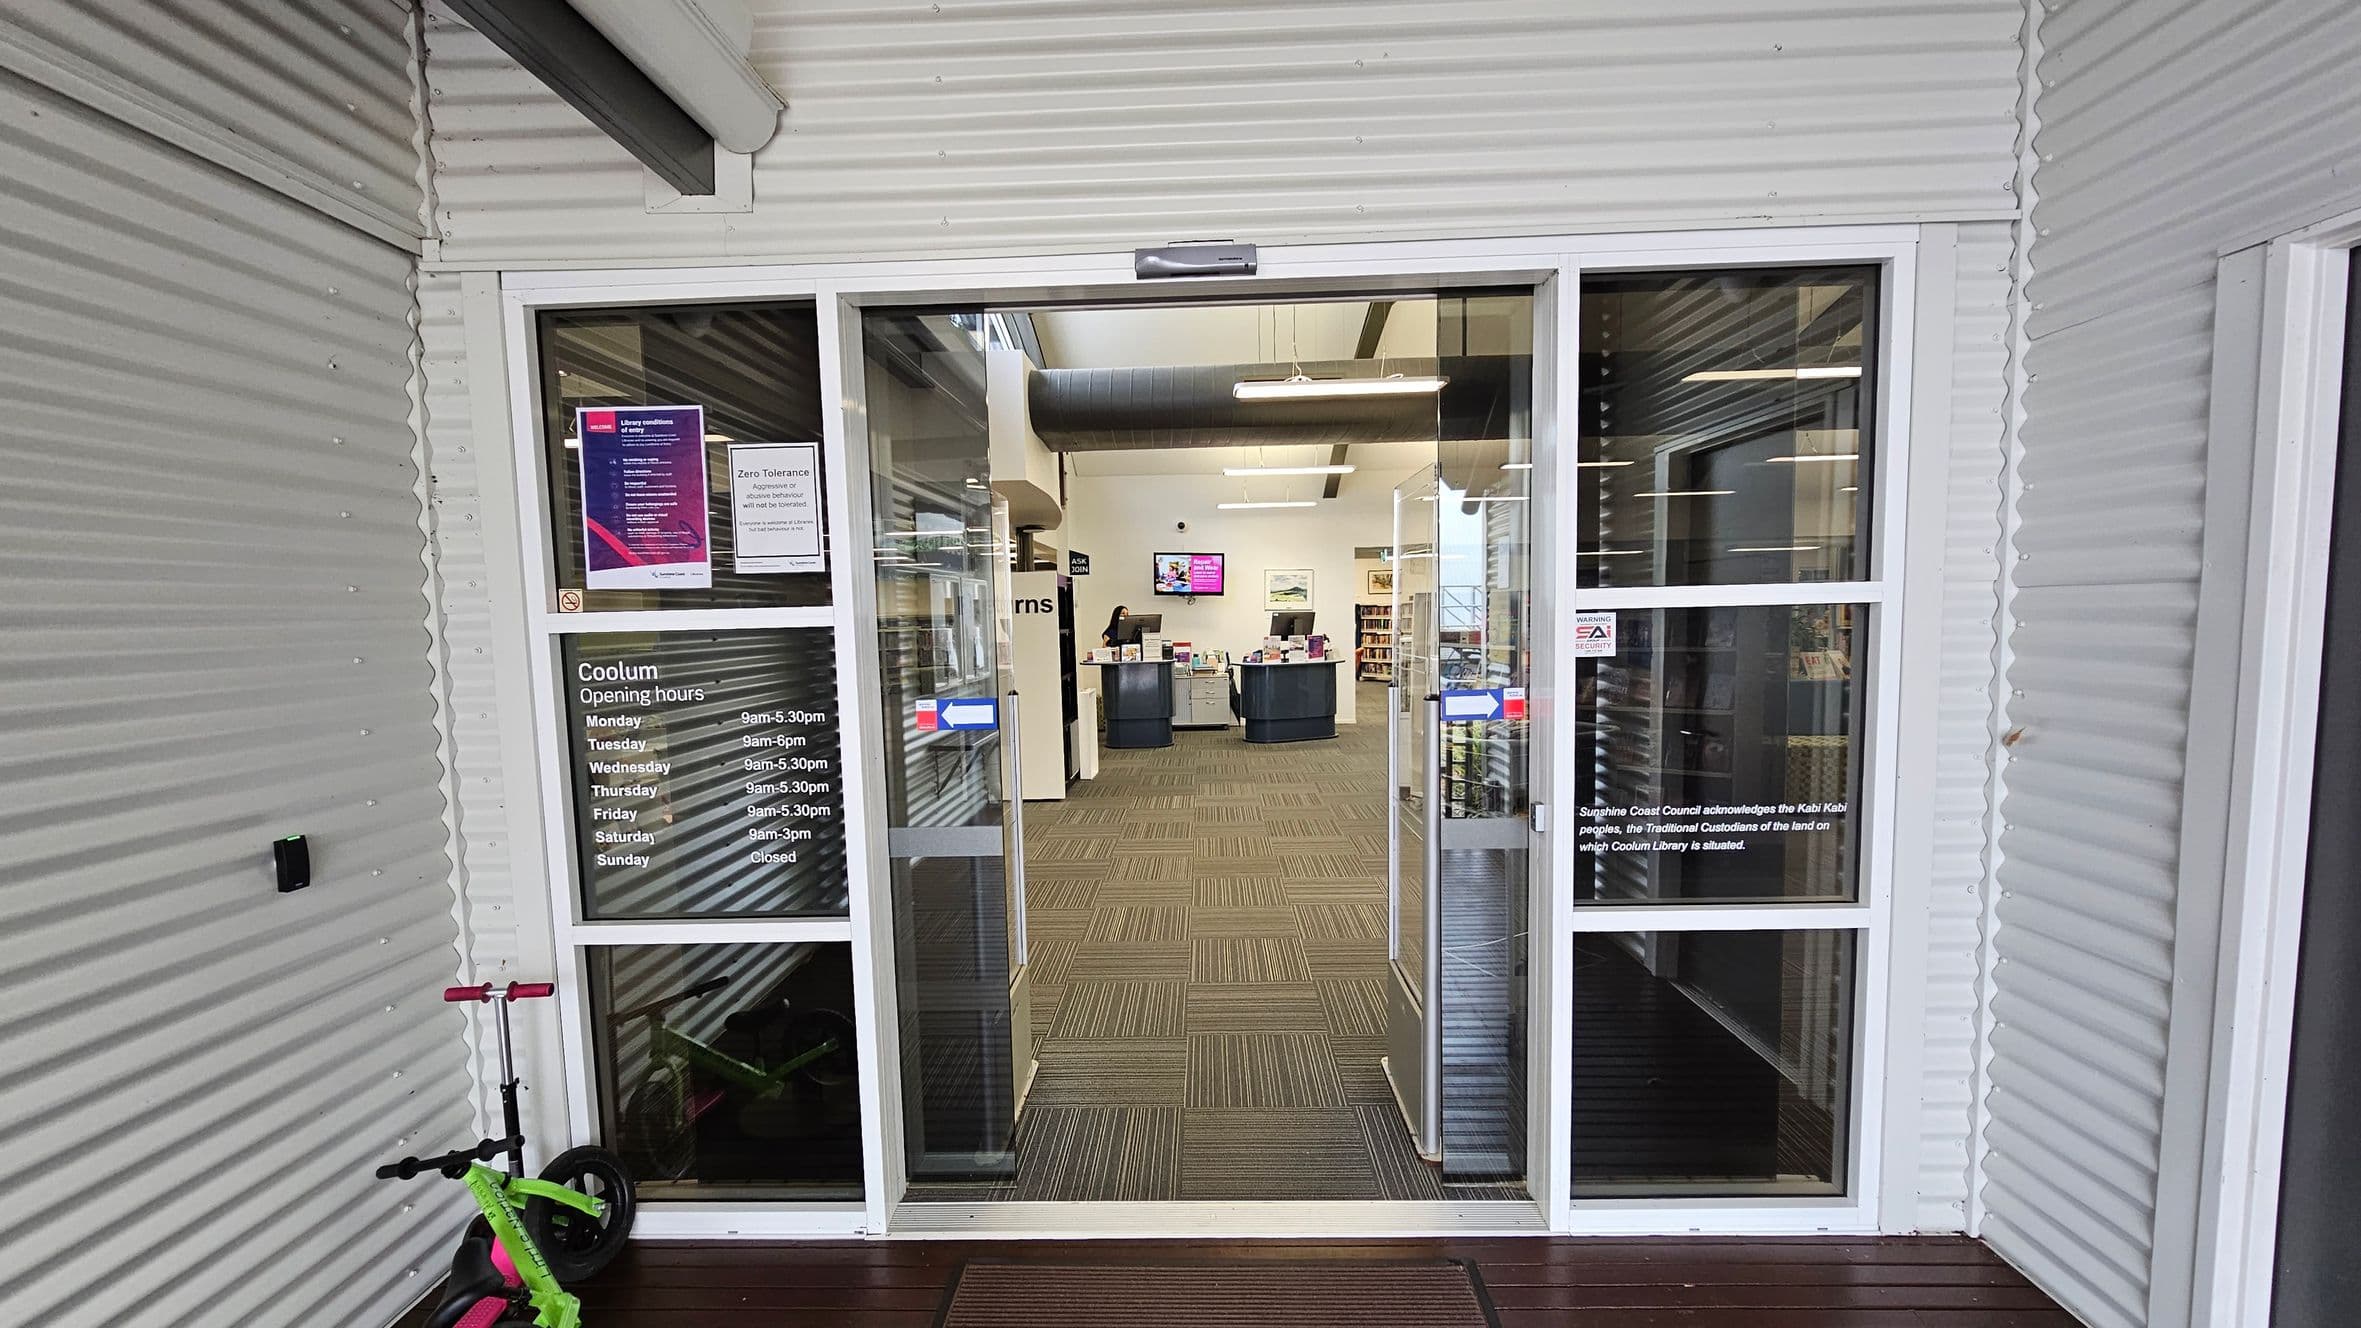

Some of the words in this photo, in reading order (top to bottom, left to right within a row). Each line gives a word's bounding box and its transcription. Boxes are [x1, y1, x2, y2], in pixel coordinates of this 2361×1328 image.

[621, 419, 642, 427] Library
[738, 469, 760, 478] Zero
[762, 468, 810, 478] Tolerance
[753, 483, 788, 491] Aggressive
[578, 661, 658, 682] Coolum
[580, 686, 651, 707] Opening
[655, 685, 705, 702] hours
[585, 714, 642, 728] Monday
[741, 711, 826, 725] 9am-5.30pm
[587, 738, 647, 752] Tuesday
[742, 735, 806, 749] 9am-6pm
[589, 761, 671, 775] Wednesday
[744, 757, 828, 771] 9am-5.30pm
[591, 784, 658, 798] Thursday
[745, 781, 829, 795] 9am-5.30pm
[593, 808, 638, 822] Friday
[747, 804, 831, 818] 9am-5.30pm
[1579, 806, 1627, 817] Sunshine
[1629, 806, 1660, 816] Coast
[1662, 805, 1701, 816] Council
[1702, 803, 1776, 817] acknowledges
[1778, 803, 1795, 814] the
[1797, 803, 1821, 814] Kabi
[1823, 802, 1847, 813] Kabi
[595, 831, 655, 845] Saturday
[748, 828, 812, 842] 9am-3pm
[1579, 824, 1623, 836] peoples,
[1626, 823, 1643, 834] the
[1646, 823, 1699, 834] Traditional
[1700, 822, 1758, 833] Custodians
[1760, 821, 1772, 832] of
[1772, 821, 1789, 831] the
[1791, 821, 1815, 831] land
[1816, 822, 1830, 831] on
[1579, 841, 1608, 852] which
[1611, 841, 1650, 852] Coolum
[1652, 841, 1688, 853] Library
[1691, 840, 1700, 851] is
[1702, 840, 1746, 851] situated.
[597, 854, 650, 868] Sunday
[750, 850, 797, 863] Closed
